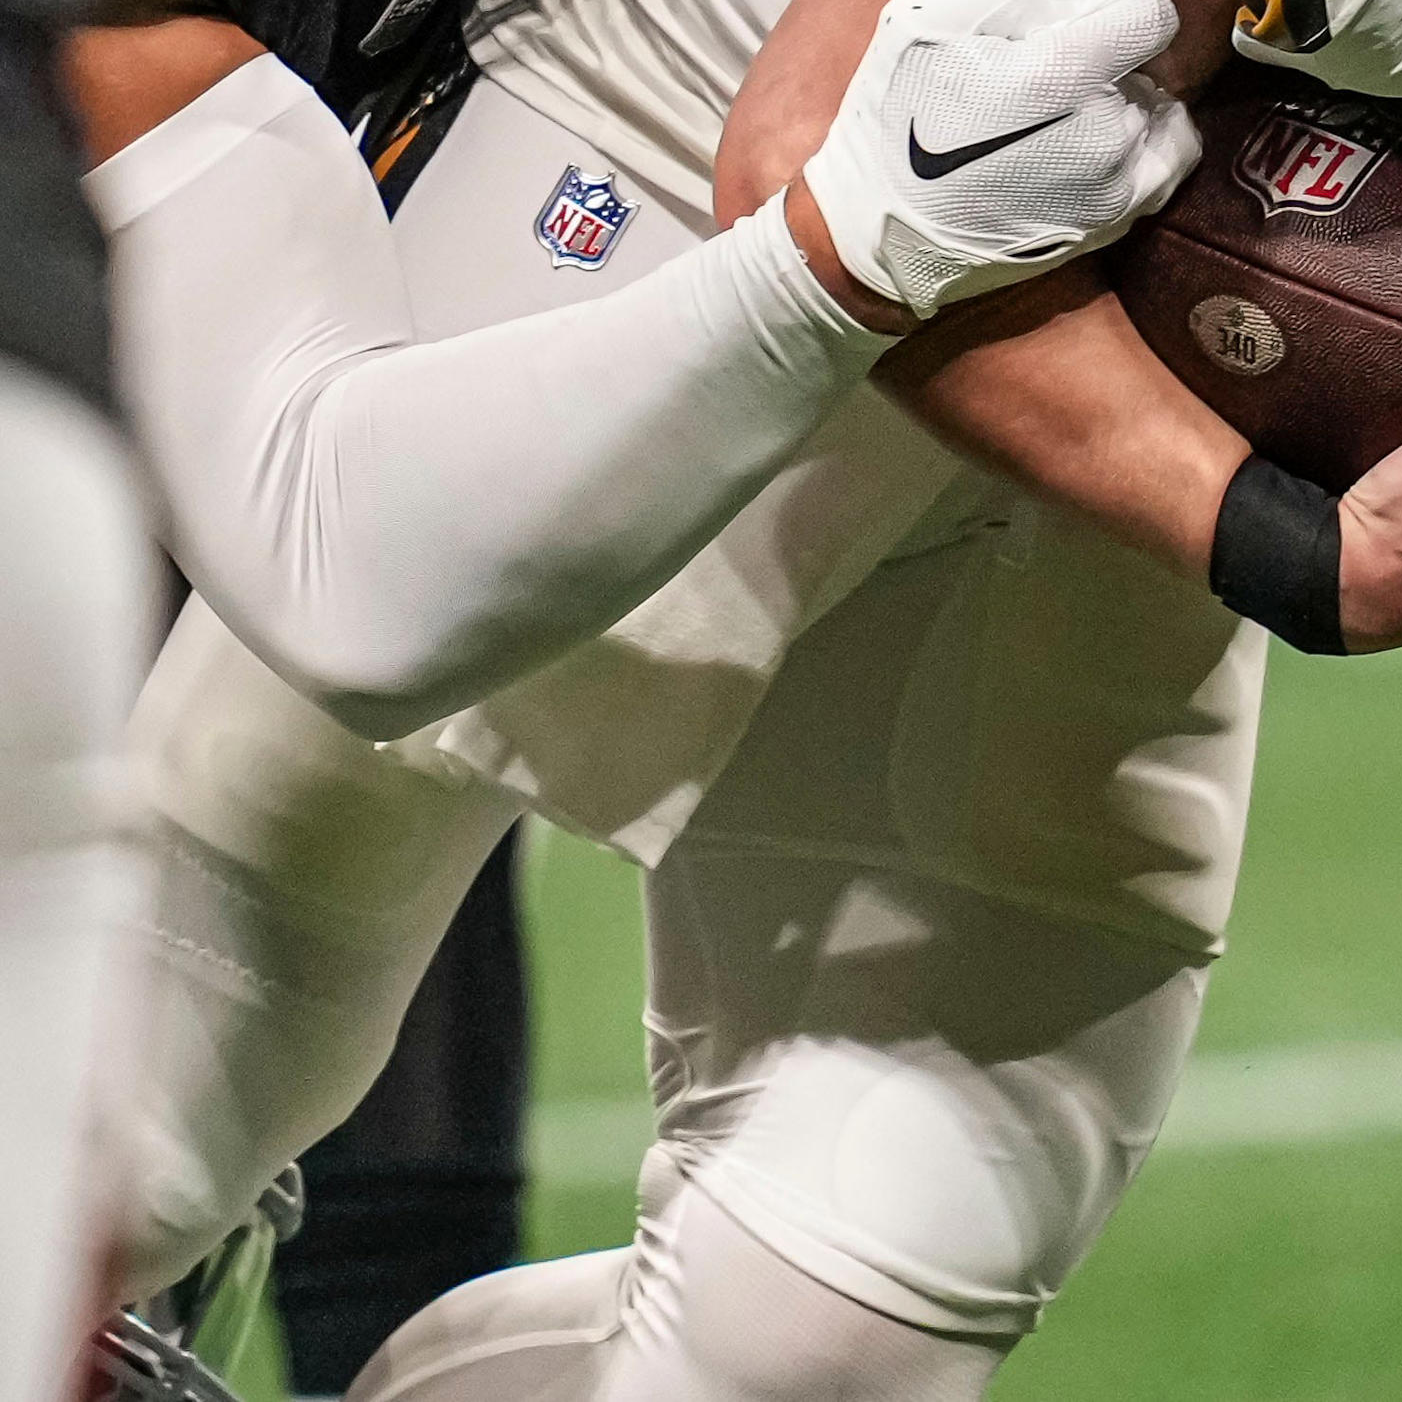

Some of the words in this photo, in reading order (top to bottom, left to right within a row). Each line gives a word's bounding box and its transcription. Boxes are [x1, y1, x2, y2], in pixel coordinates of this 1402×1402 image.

[1242, 117, 1357, 200] NFL
[547, 203, 604, 257] NFL
[1217, 325, 1256, 365] 340
